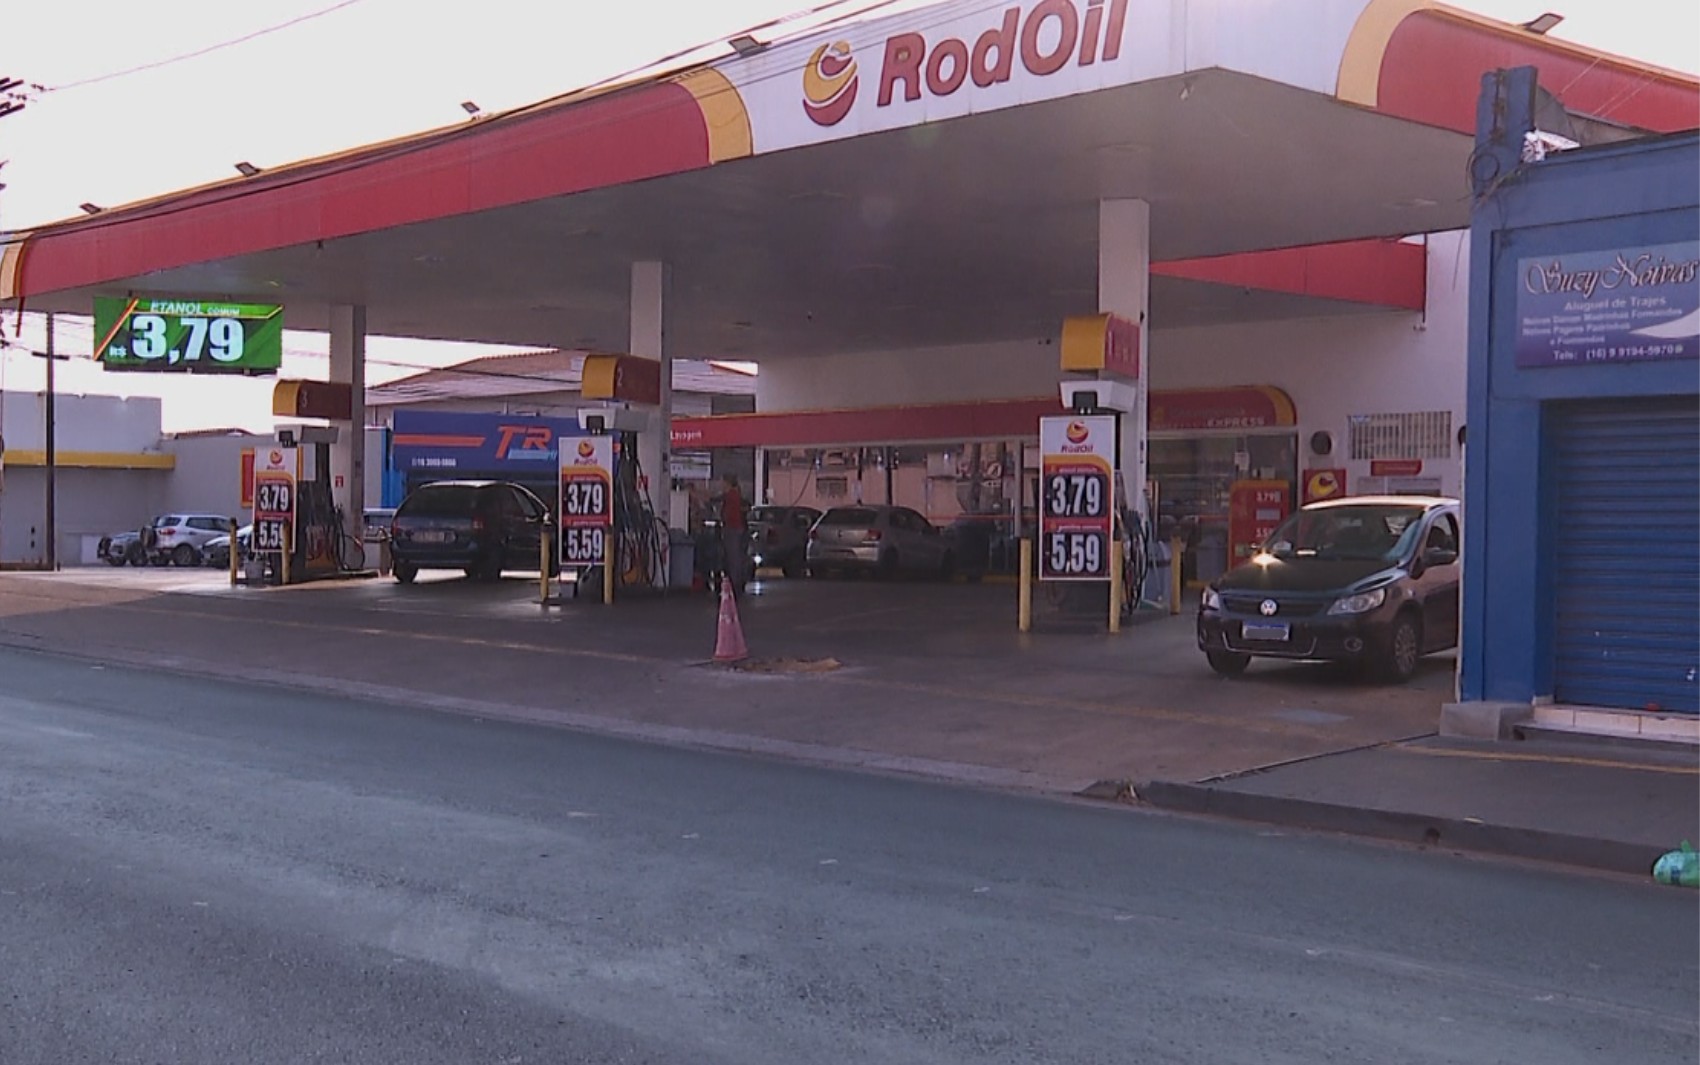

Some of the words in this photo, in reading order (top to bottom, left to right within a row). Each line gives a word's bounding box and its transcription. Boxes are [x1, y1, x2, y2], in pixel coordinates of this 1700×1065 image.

[877, 0, 1127, 107] RodOil
[1526, 261, 1598, 298] Suzy
[1601, 253, 1699, 289] Noivas
[150, 302, 203, 315] ETANOL
[1565, 300, 1608, 311] Aluguel
[1612, 298, 1626, 308] de
[1631, 296, 1666, 308] Trajes
[132, 315, 244, 364] 3,79
[496, 425, 552, 459] TR
[1052, 475, 1101, 516] 3,79
[1051, 534, 1101, 573] 5,59
